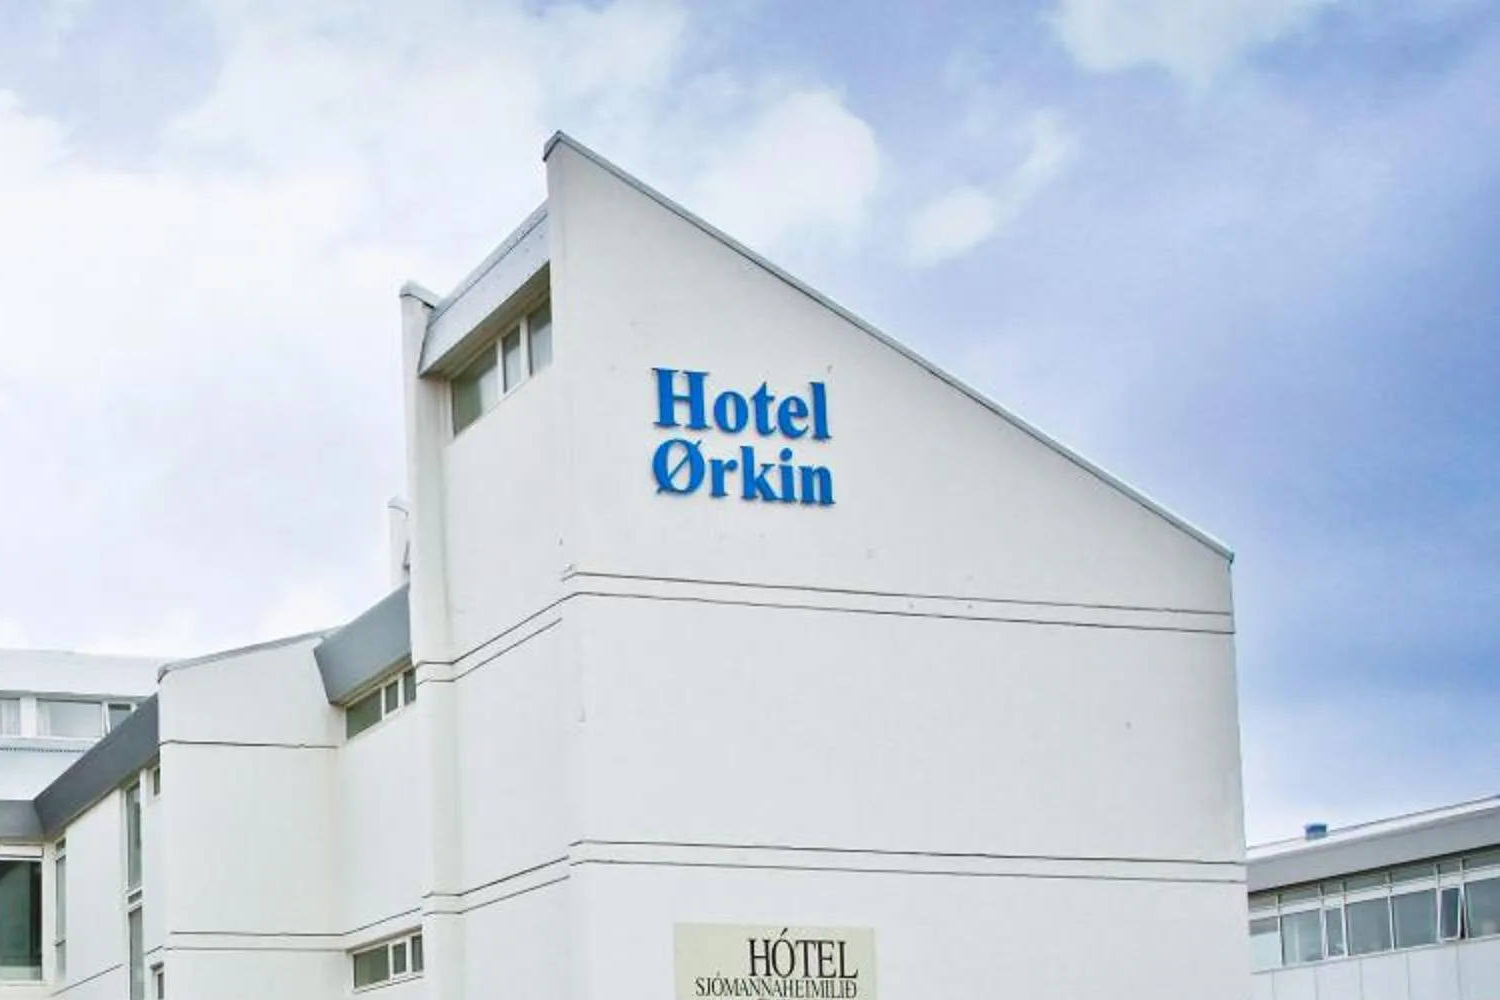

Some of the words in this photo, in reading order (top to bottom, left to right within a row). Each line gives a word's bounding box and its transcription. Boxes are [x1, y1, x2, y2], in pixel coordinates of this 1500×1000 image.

[651, 367, 832, 441] Hotel
[652, 438, 836, 506] Ørkin
[748, 927, 859, 979] HÓTEL
